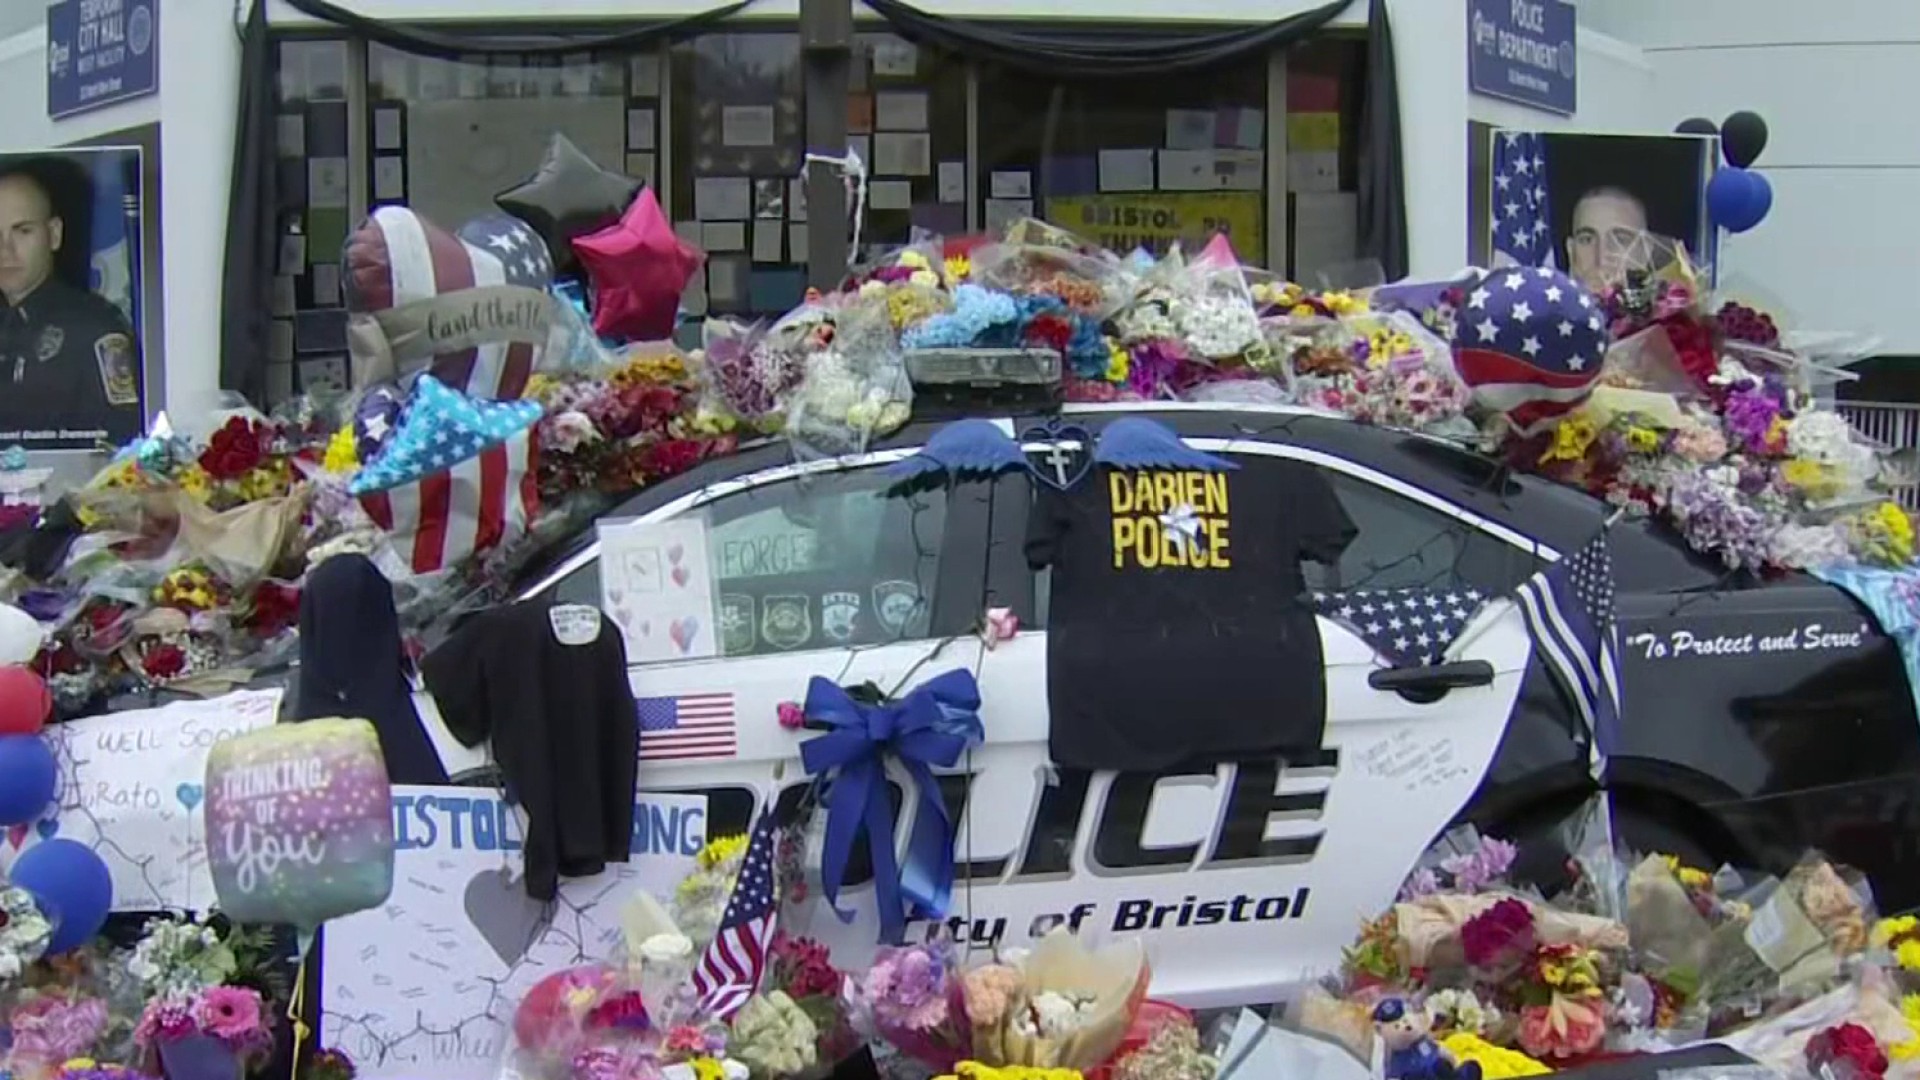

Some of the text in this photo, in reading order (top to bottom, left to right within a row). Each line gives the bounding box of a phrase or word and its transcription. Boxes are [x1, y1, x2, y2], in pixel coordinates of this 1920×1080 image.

[79, 13, 124, 53] CITY HALL
[1512, 0, 1544, 34] POLICE
[1498, 30, 1557, 72] DEPARTMENT
[1083, 205, 1183, 229] BRISTOL
[1108, 471, 1230, 514] DARIEN
[1671, 631, 1753, 657] Protect
[1758, 628, 1797, 650] and
[97, 728, 162, 752] WELL
[222, 757, 323, 800] THINKING
[256, 797, 278, 825] OF
[391, 795, 704, 855] ISTOL ONG
[1029, 903, 1097, 937] of
[1112, 887, 1311, 932] Bristol
